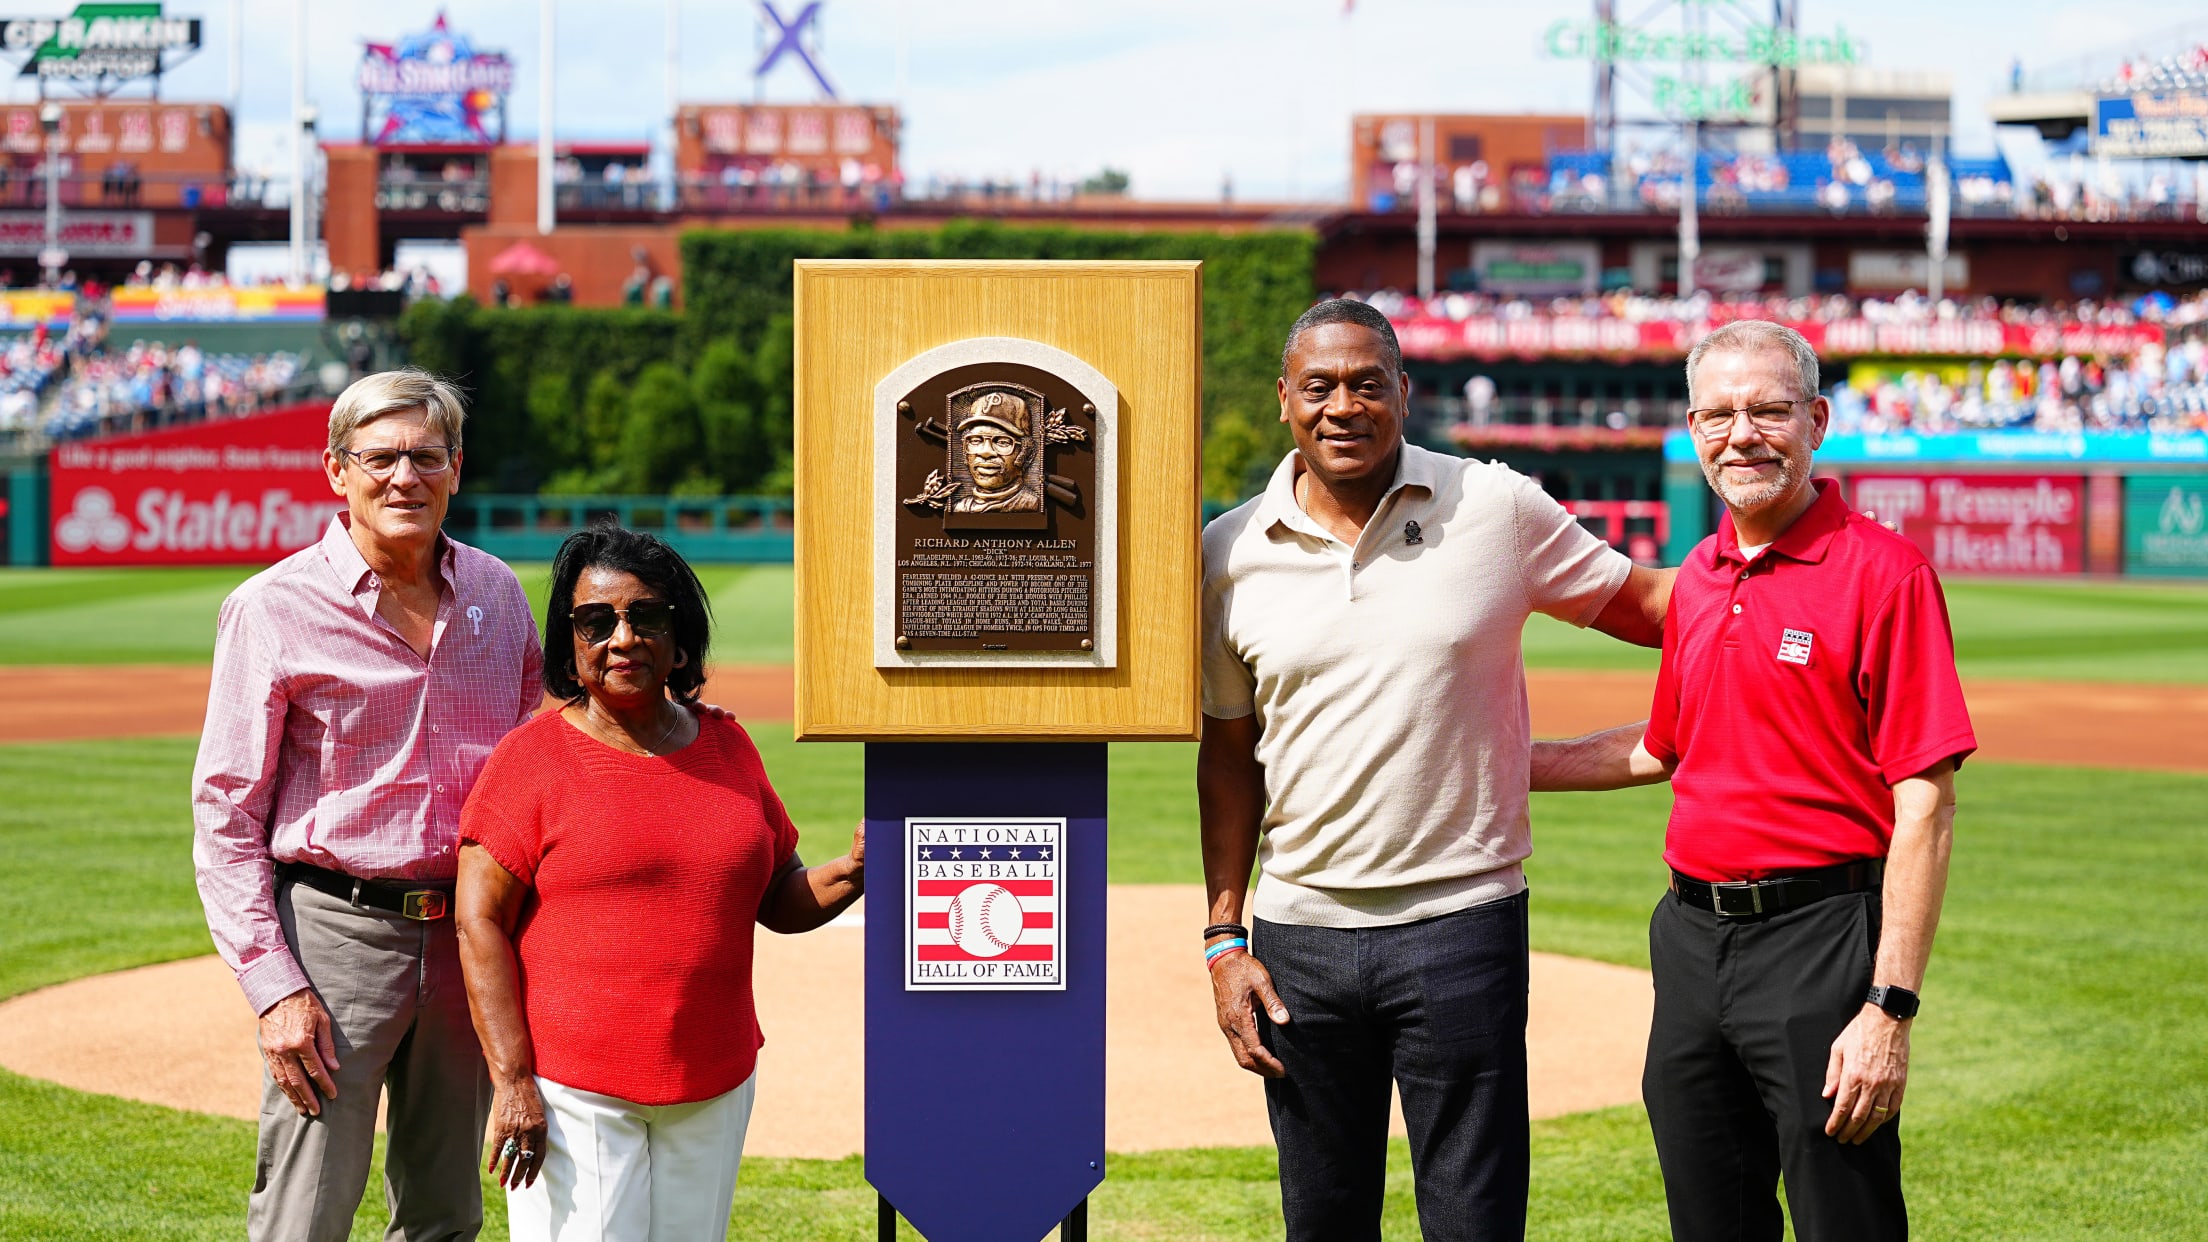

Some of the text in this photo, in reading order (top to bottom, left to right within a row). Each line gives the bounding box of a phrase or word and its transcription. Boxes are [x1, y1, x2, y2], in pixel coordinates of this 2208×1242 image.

[1747, 22, 1857, 65] Bank
[1654, 75, 1752, 116] Park
[1930, 478, 2074, 530] Temple
[914, 538, 1077, 549] RICHARD ANTHONY ALLEN
[1933, 525, 2064, 573] Health
[918, 828, 1054, 842] NATIONAL
[918, 864, 1054, 878] BASEBALL
[918, 964, 1054, 978] HALL OF FAME
